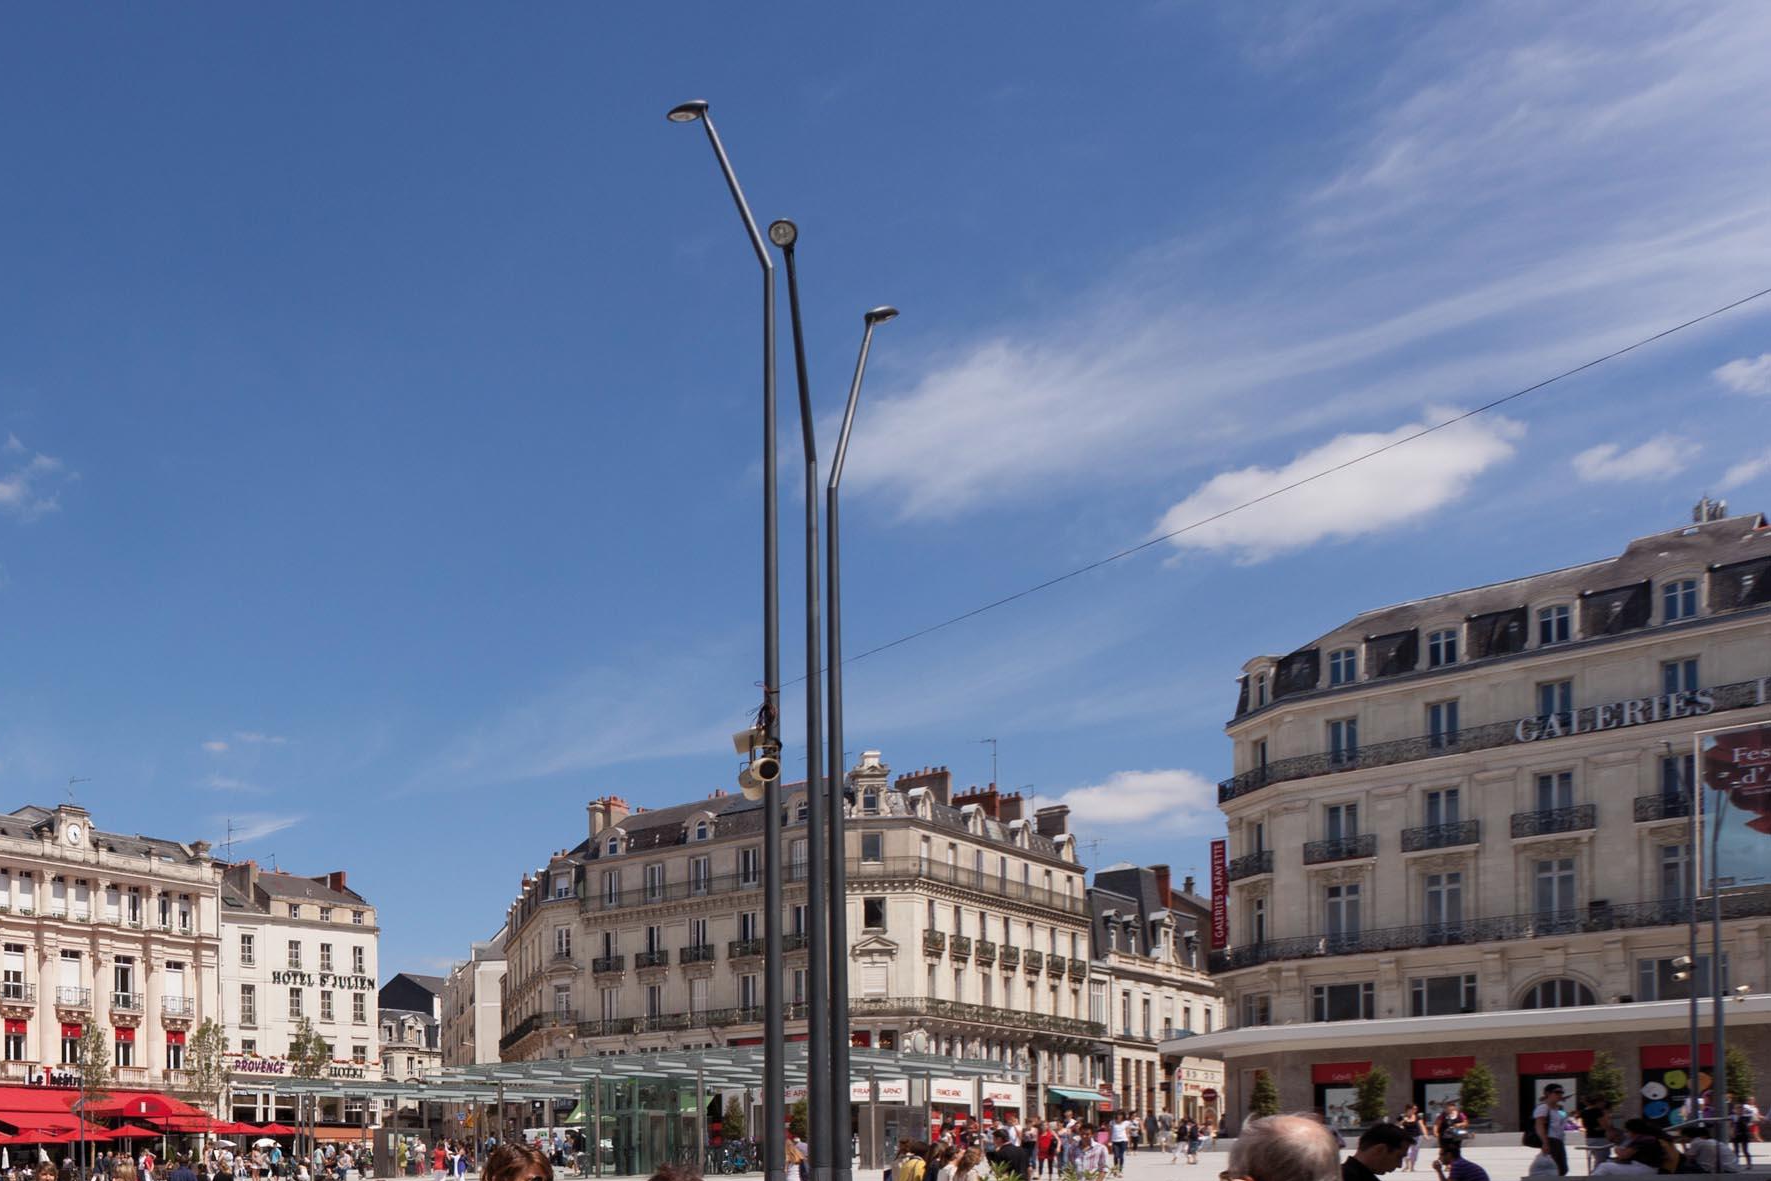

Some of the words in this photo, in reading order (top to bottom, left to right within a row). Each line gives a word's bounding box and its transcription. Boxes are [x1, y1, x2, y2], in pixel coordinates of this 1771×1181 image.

[1515, 687, 1715, 743] GALERIES
[1213, 843, 1224, 891] LAFAYETTE
[1214, 894, 1224, 938] GALERIES
[272, 971, 315, 986] HOTEL
[332, 976, 375, 991] JULIEN
[28, 1064, 44, 1085] Le
[234, 1060, 285, 1074] PROVENCE
[329, 1066, 366, 1079] HOTEL
